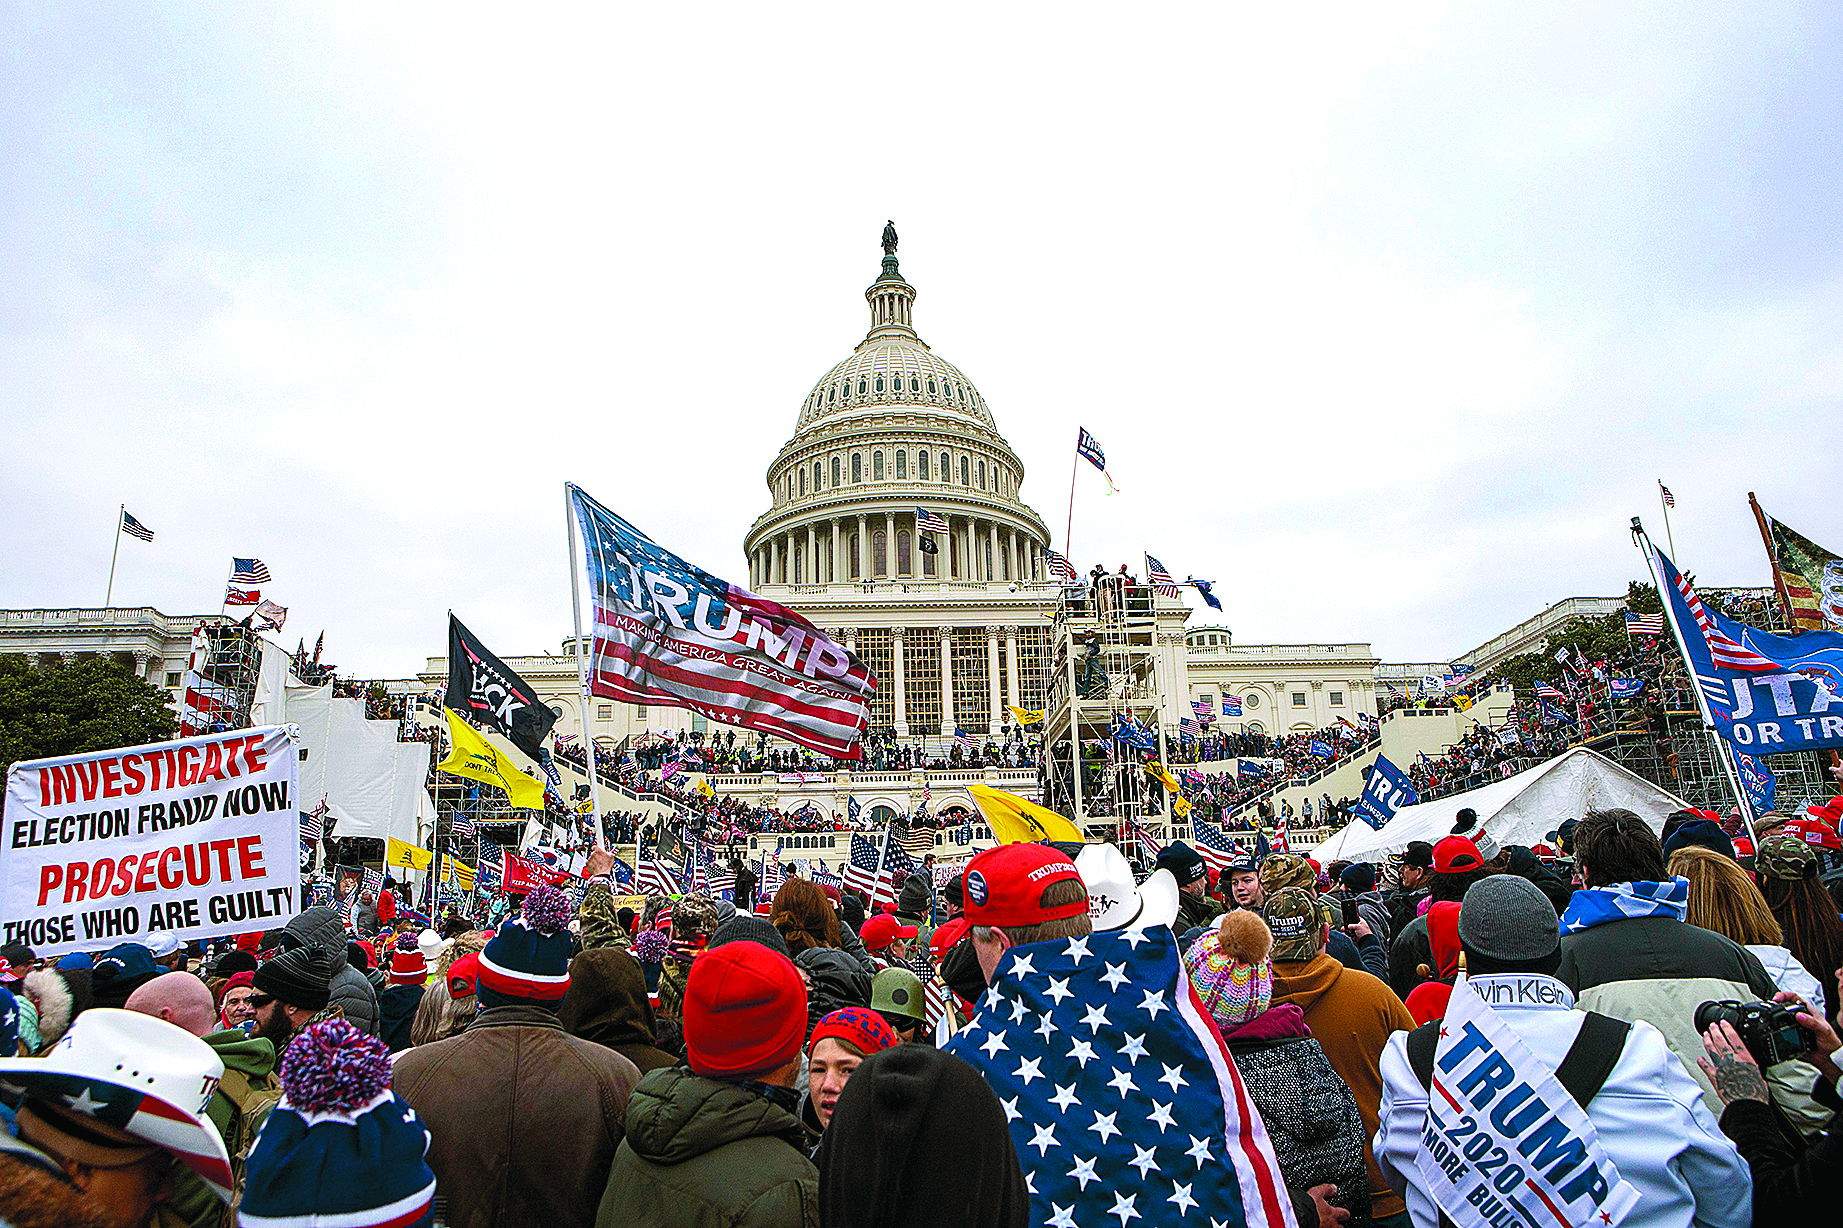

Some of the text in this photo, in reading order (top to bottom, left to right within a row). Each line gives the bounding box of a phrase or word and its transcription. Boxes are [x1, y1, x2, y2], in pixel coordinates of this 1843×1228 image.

[615, 553, 850, 678] TRUMP
[615, 615, 853, 701] MAKING AMERICA GREAT AGAIN!
[405, 696, 415, 737] TRUMP
[1733, 722, 1784, 745] OR
[38, 733, 269, 807] INVESTIGATE
[11, 780, 292, 849] ELECTION FRAUD NOW.
[37, 835, 267, 907] PROSECUTE
[812, 874, 843, 890] TRUMP
[3, 886, 293, 947] THOSE WHO ARE GUILTY
[1268, 915, 1304, 927] Trump
[1473, 979, 1565, 1005] lvin Klein
[1437, 1020, 1608, 1206] TRUMP
[1422, 1126, 1525, 1228] MORE BULLS
[1444, 1115, 1526, 1195] 2020
